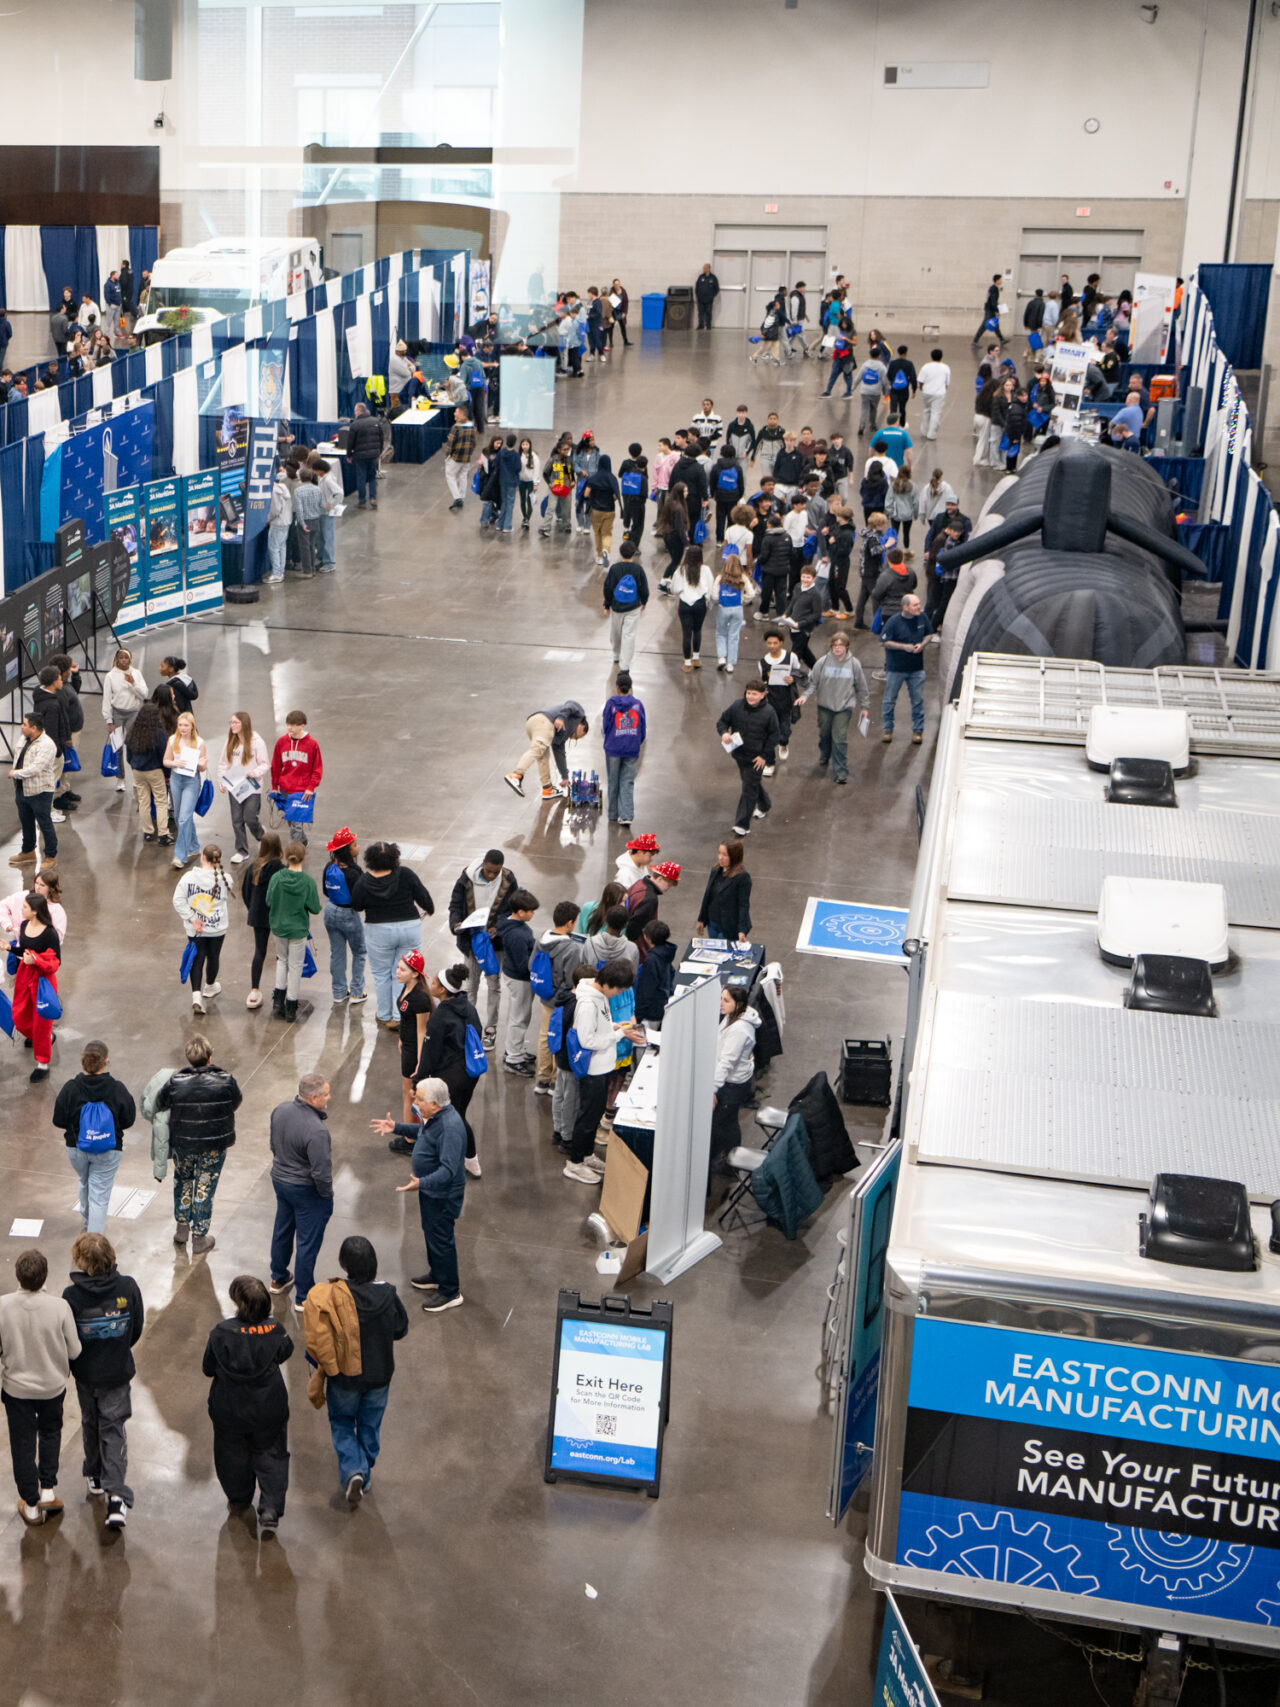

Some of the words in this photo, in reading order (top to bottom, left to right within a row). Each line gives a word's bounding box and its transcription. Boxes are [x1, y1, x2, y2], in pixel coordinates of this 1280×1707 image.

[249, 422, 278, 499] TECH
[574, 1336, 636, 1350] MANUFACTURING
[637, 1343, 652, 1351] LAB
[579, 1329, 619, 1340] EASTCONN
[620, 1334, 647, 1344] MOBILE
[576, 1374, 604, 1389] Exit
[608, 1378, 643, 1394] Here
[1012, 1353, 1222, 1405] EASTCONN
[576, 1388, 593, 1397] Scan
[594, 1390, 607, 1399] the
[608, 1392, 620, 1401] QR
[622, 1394, 641, 1403] Code
[570, 1397, 581, 1405] for
[582, 1397, 602, 1407] More
[603, 1400, 646, 1412] Information
[570, 1451, 636, 1466] eastconn.org/Lab
[1022, 1439, 1086, 1471] See
[1101, 1450, 1181, 1485] Your
[1190, 1463, 1280, 1502] Futur
[1017, 1468, 1280, 1532] MANUFACTUR
